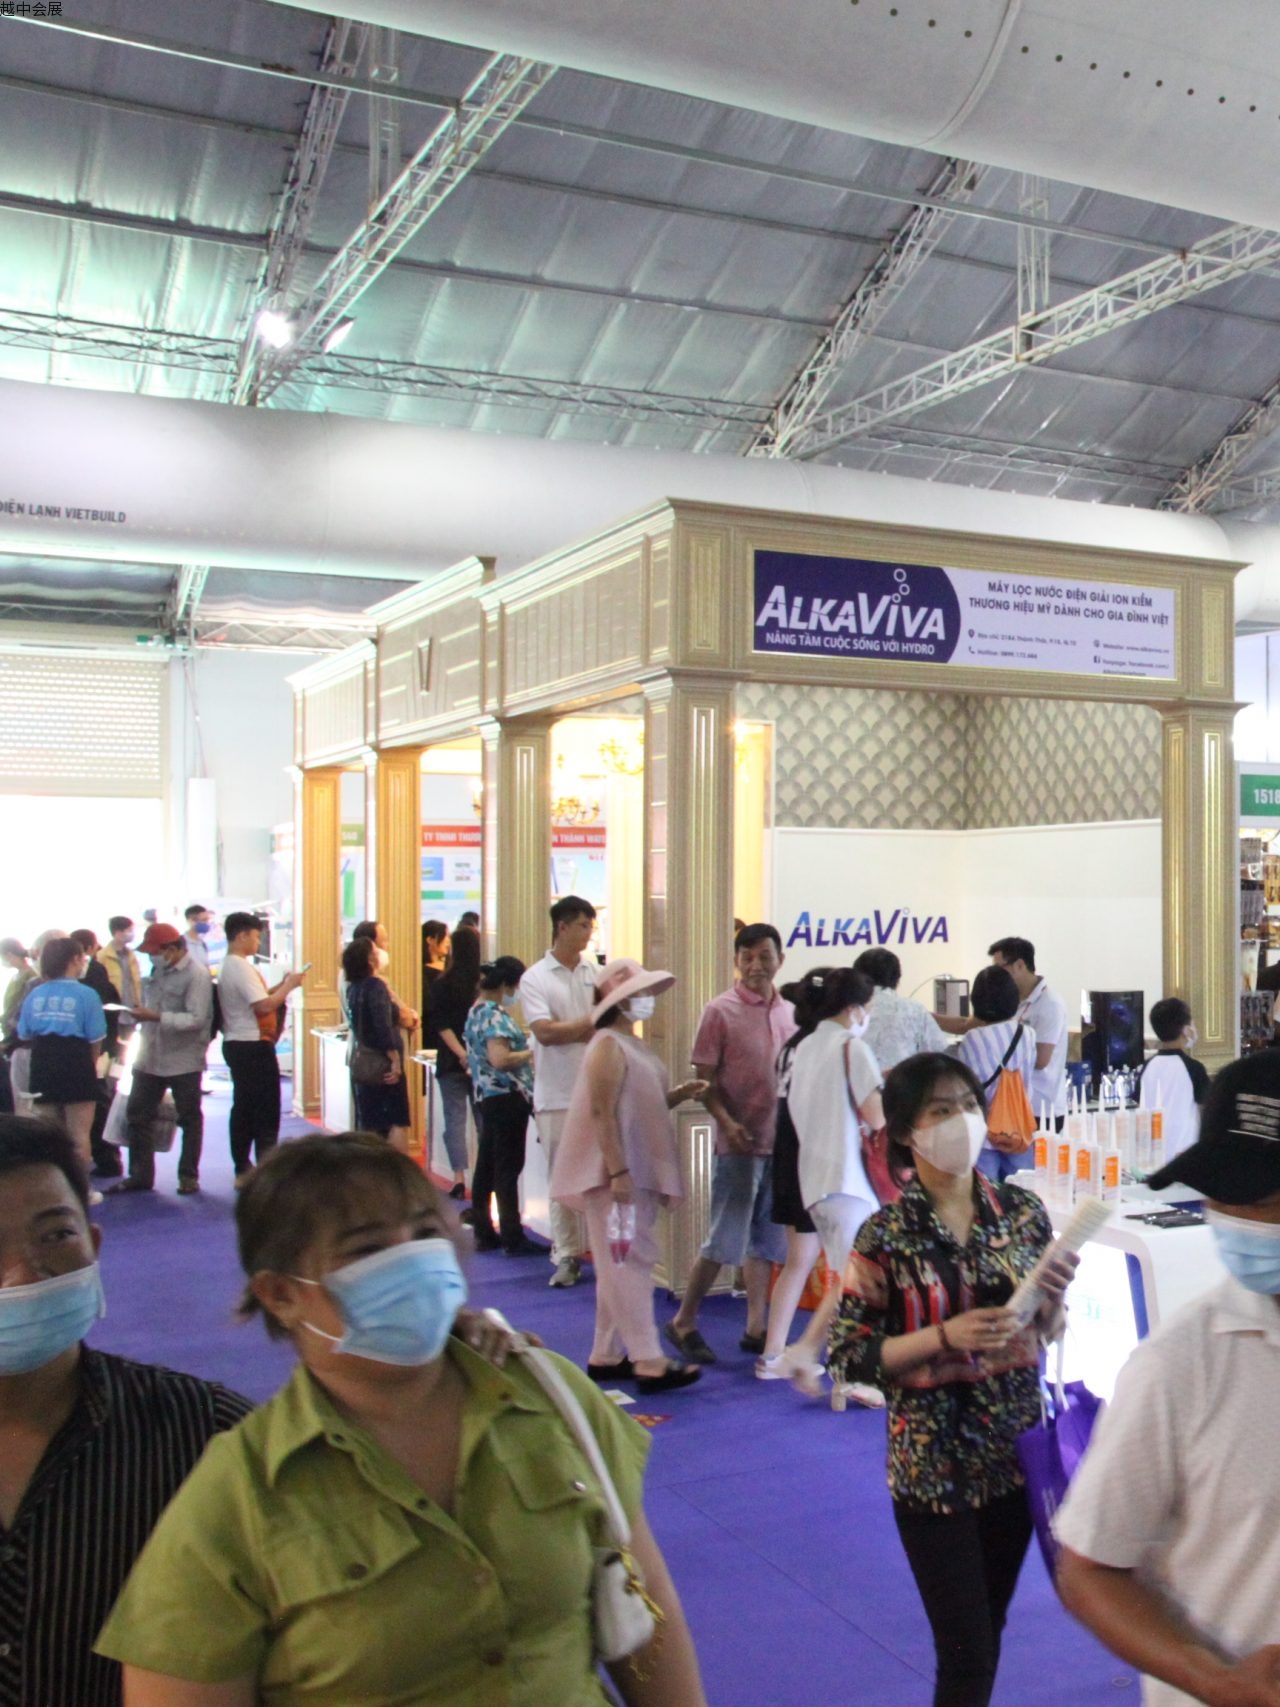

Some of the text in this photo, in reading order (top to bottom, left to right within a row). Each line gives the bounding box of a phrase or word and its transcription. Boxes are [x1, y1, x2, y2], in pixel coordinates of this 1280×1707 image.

[65, 507, 126, 523] VIETBUILD
[988, 580, 1009, 593] MÁY
[1013, 584, 1032, 598] LỌC
[1035, 585, 1063, 598] NƯỚC
[1066, 588, 1087, 602] ĐIỆN
[1113, 594, 1128, 604] ION
[969, 597, 1010, 610] THƯƠNG
[1013, 600, 1034, 615] HIỆU
[1054, 603, 1080, 616] DÀNH
[1084, 608, 1104, 619] CHO
[1107, 610, 1124, 621] GIA
[1127, 610, 1149, 623] ĐÌNH
[1152, 613, 1169, 628] VIỆT
[766, 630, 935, 655] NÂNG TẦM CUỘC SỐNG VỚI HYDRO
